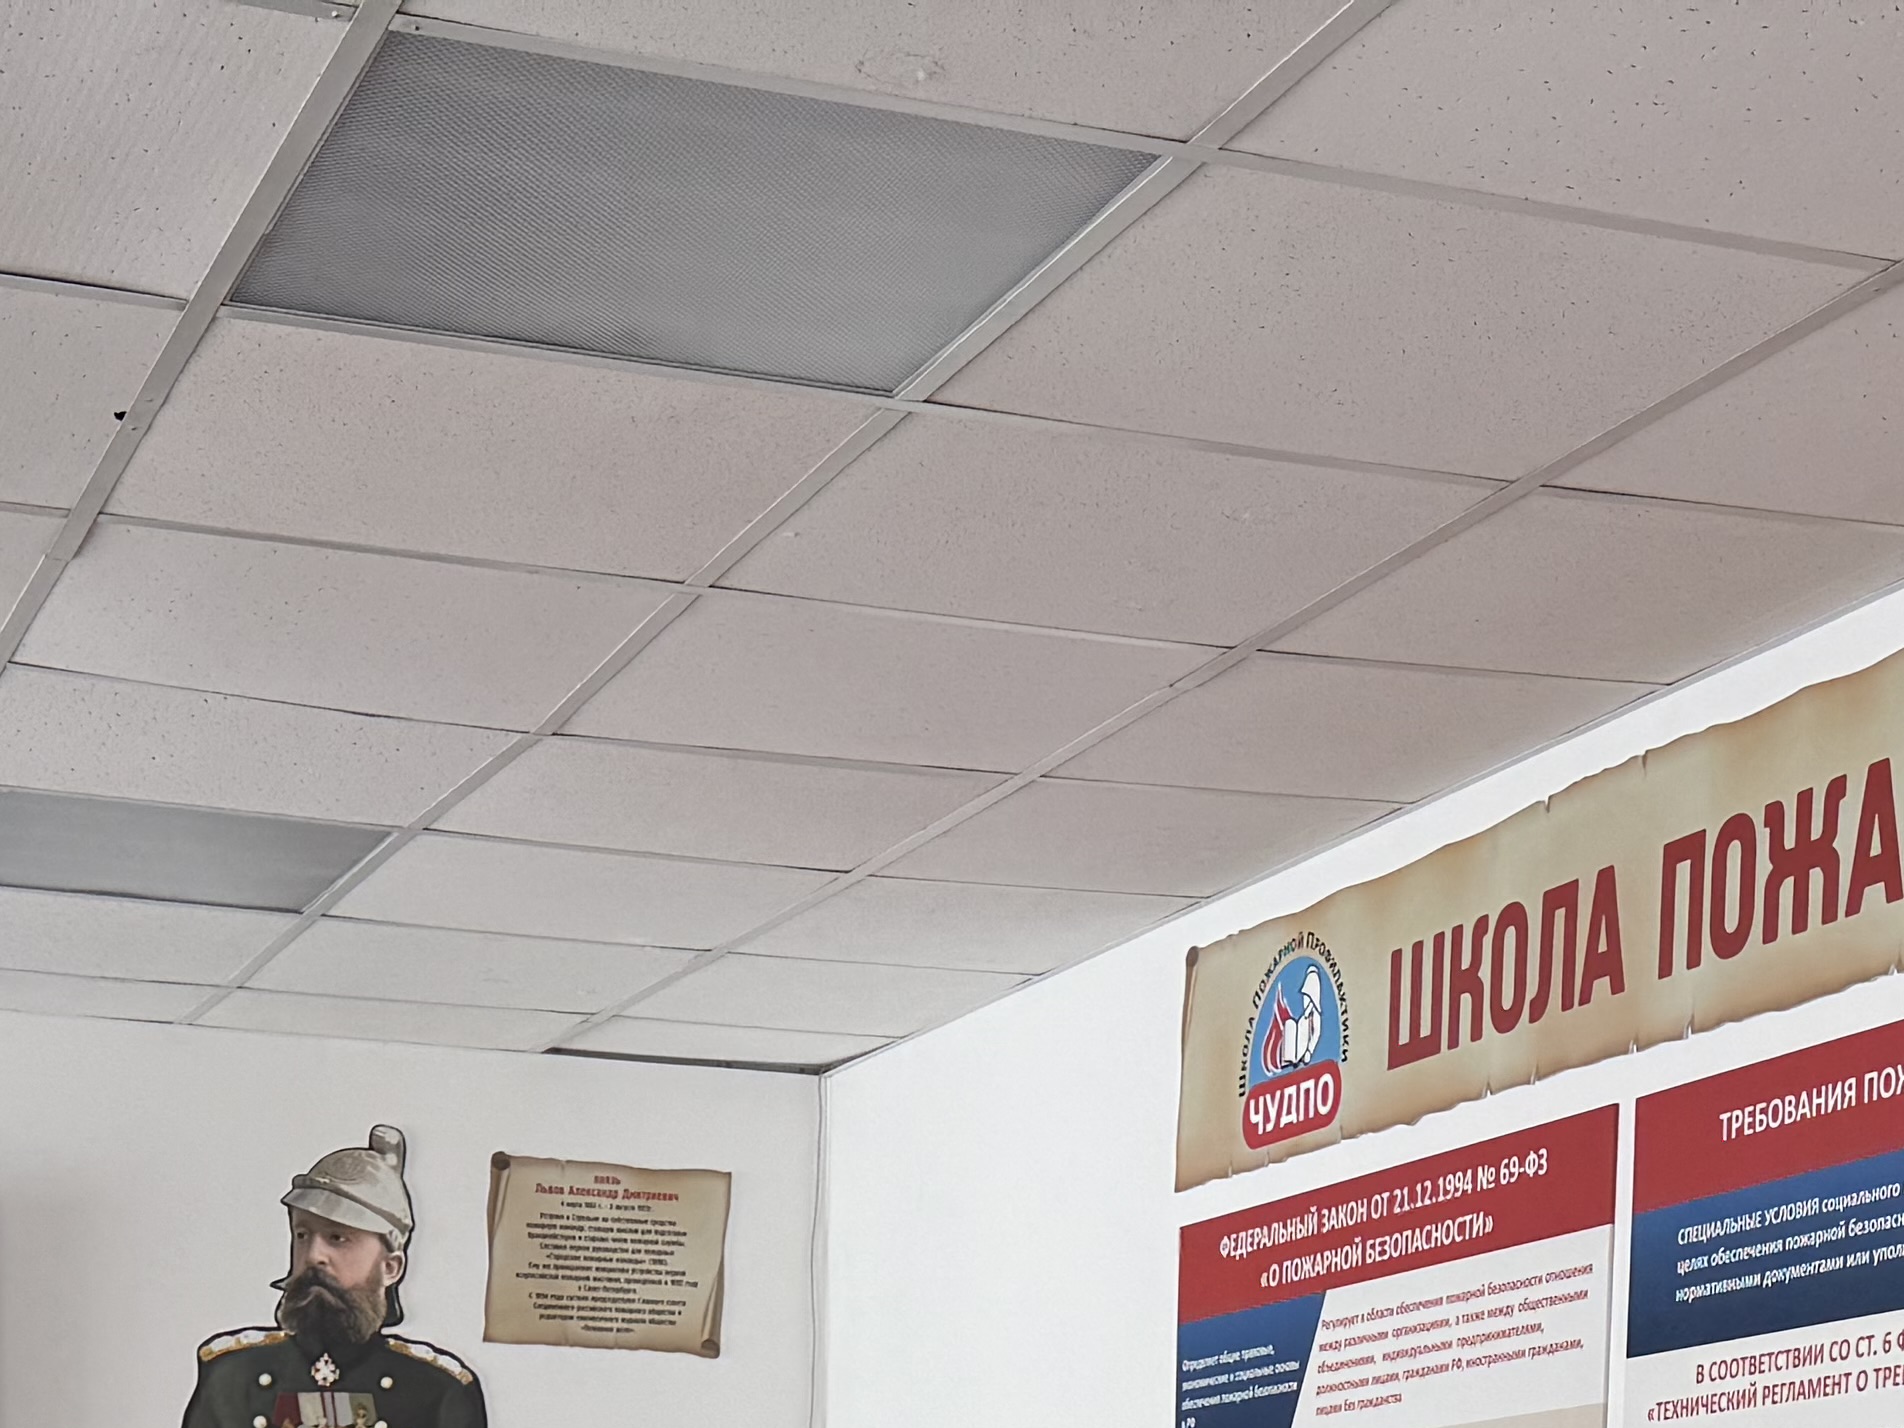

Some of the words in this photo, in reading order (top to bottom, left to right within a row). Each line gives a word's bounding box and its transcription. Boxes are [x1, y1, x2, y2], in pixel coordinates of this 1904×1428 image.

[1388, 865, 1625, 1071] ШКОЛА
[1250, 1073, 1334, 1135] ЧУДПО
[1720, 1077, 1856, 1141] ТРЕБОВАНИЯ
[1220, 1206, 1318, 1261] ФЕДЕРАЛЬНЫЙ
[1321, 1198, 1368, 1234] ЗАКОН
[1371, 1192, 1390, 1220] ОТ
[1393, 1169, 1473, 1214] 21.12.1994
[1477, 1165, 1496, 1192] №
[1500, 1148, 1548, 1185] 69-ФЗ
[1261, 1264, 1280, 1288] «О
[1282, 1237, 1362, 1285] ПОЖАРНОЙ
[1366, 1212, 1493, 1264] БЕЗОПАСНОСТИ»
[1696, 1364, 1705, 1385] В
[1709, 1343, 1825, 1383] СООТВЕТСТВИИ
[1829, 1339, 1851, 1363] СО
[1856, 1334, 1878, 1358] СТ.
[1883, 1332, 1892, 1354] 6
[1648, 1387, 1757, 1422] «ТЕХНИЧЕСКИЙ
[1762, 1372, 1853, 1406] РЕГЛАМЕНТ
[1856, 1370, 1869, 1392] О
